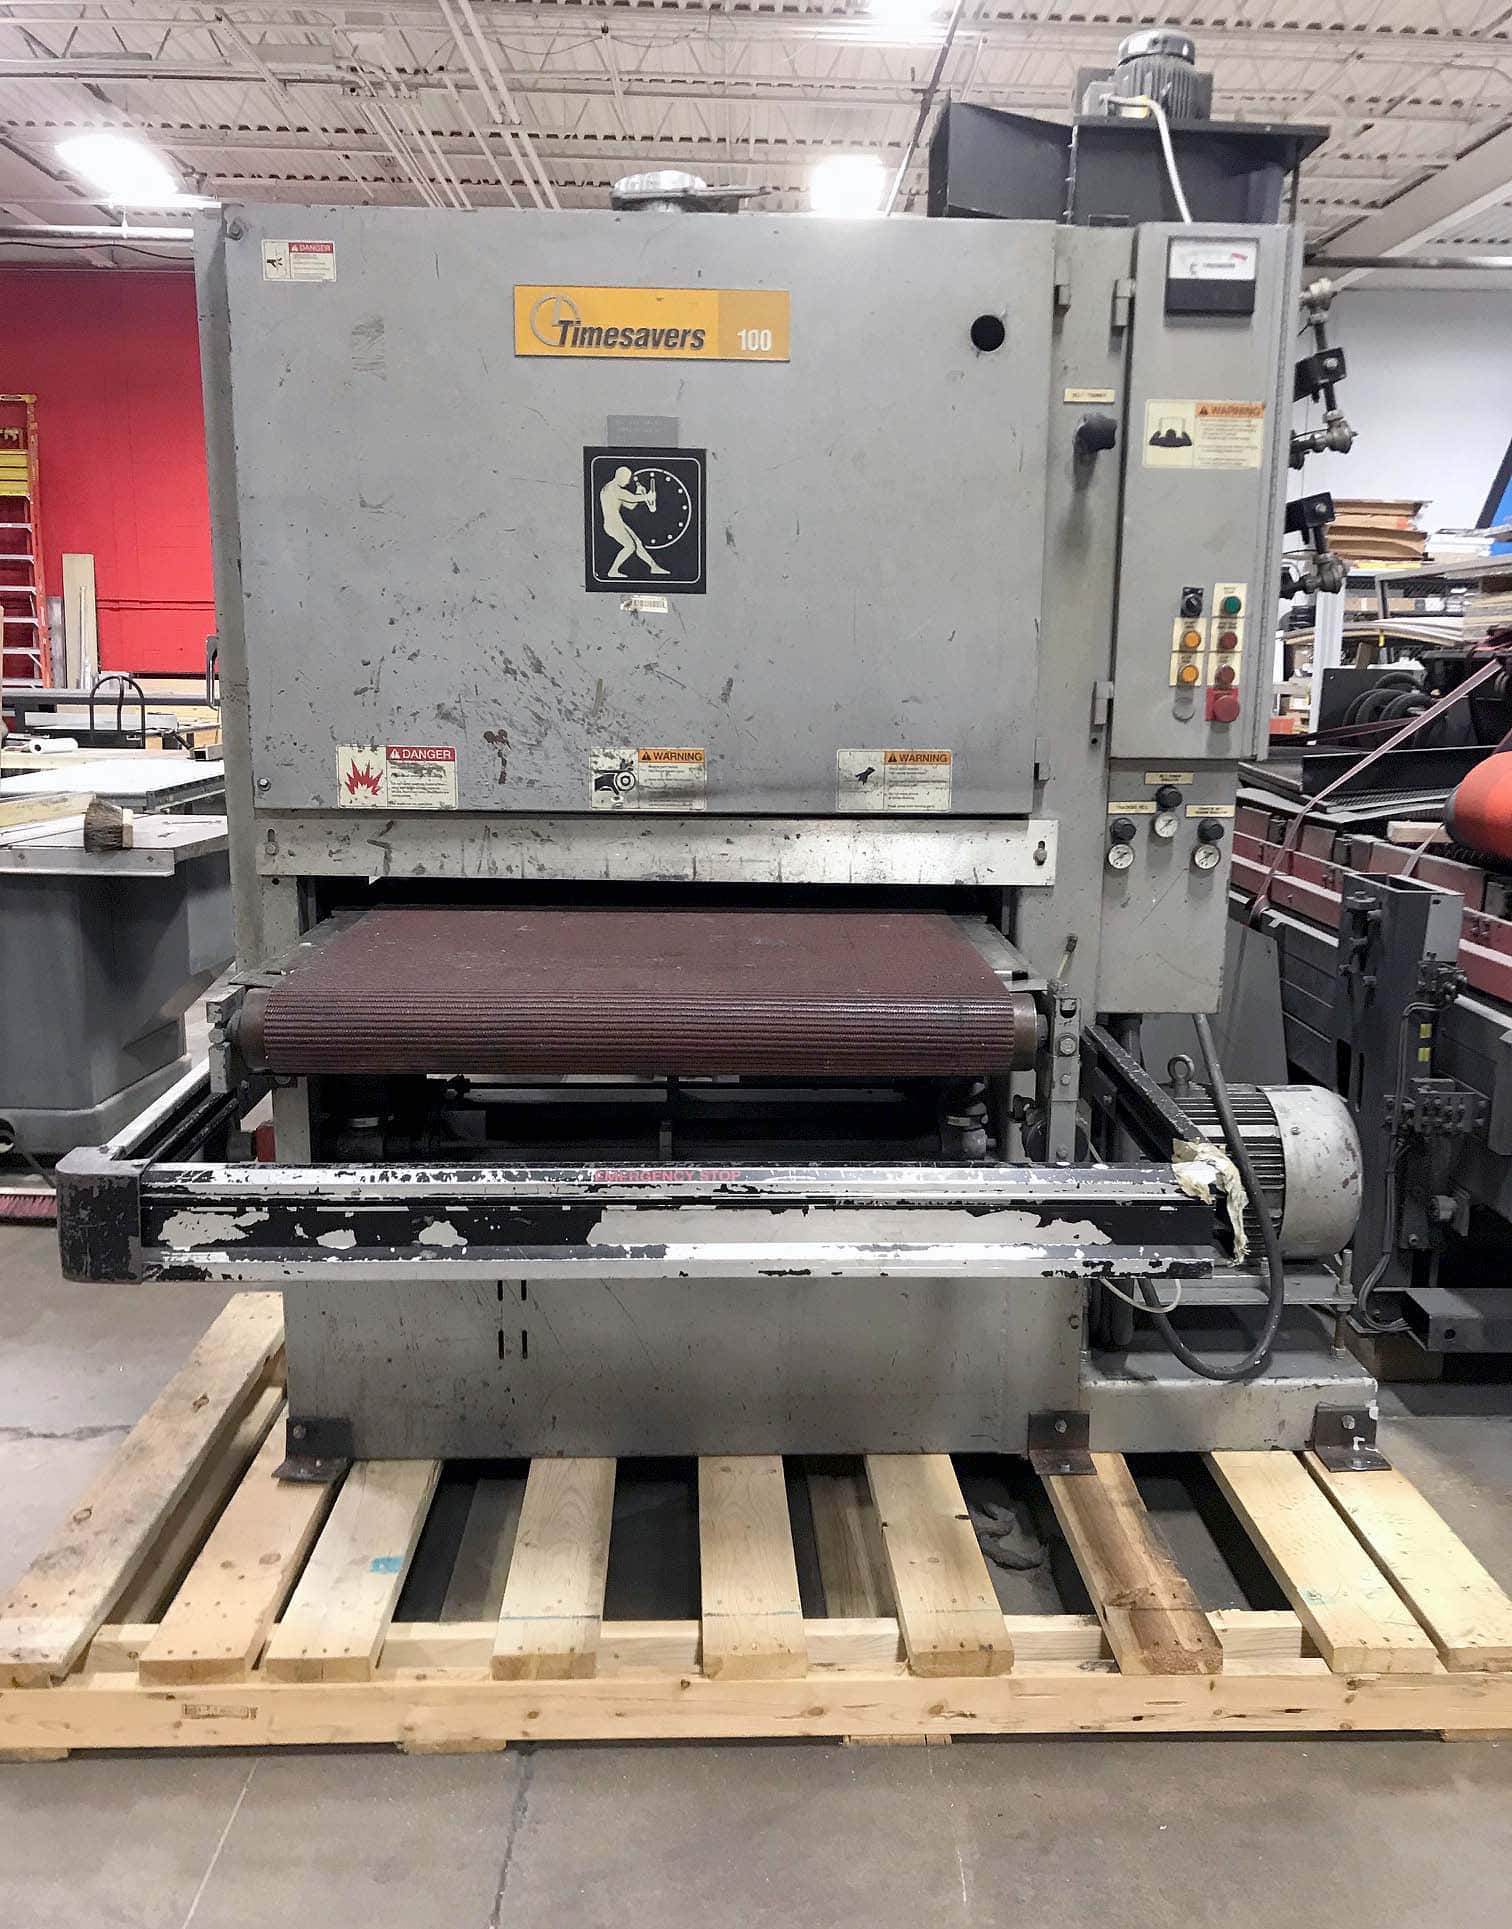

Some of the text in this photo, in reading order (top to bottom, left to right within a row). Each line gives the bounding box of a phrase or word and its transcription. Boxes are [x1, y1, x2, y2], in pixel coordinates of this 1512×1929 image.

[300, 244, 331, 252] DANGER
[557, 319, 773, 352] Timesavers 100
[1211, 406, 1261, 416] WARNING
[402, 749, 451, 760] DANGER
[653, 752, 703, 761] WARNING
[899, 753, 947, 763] WARNING
[594, 1170, 741, 1182] EMERGENCY STOP
